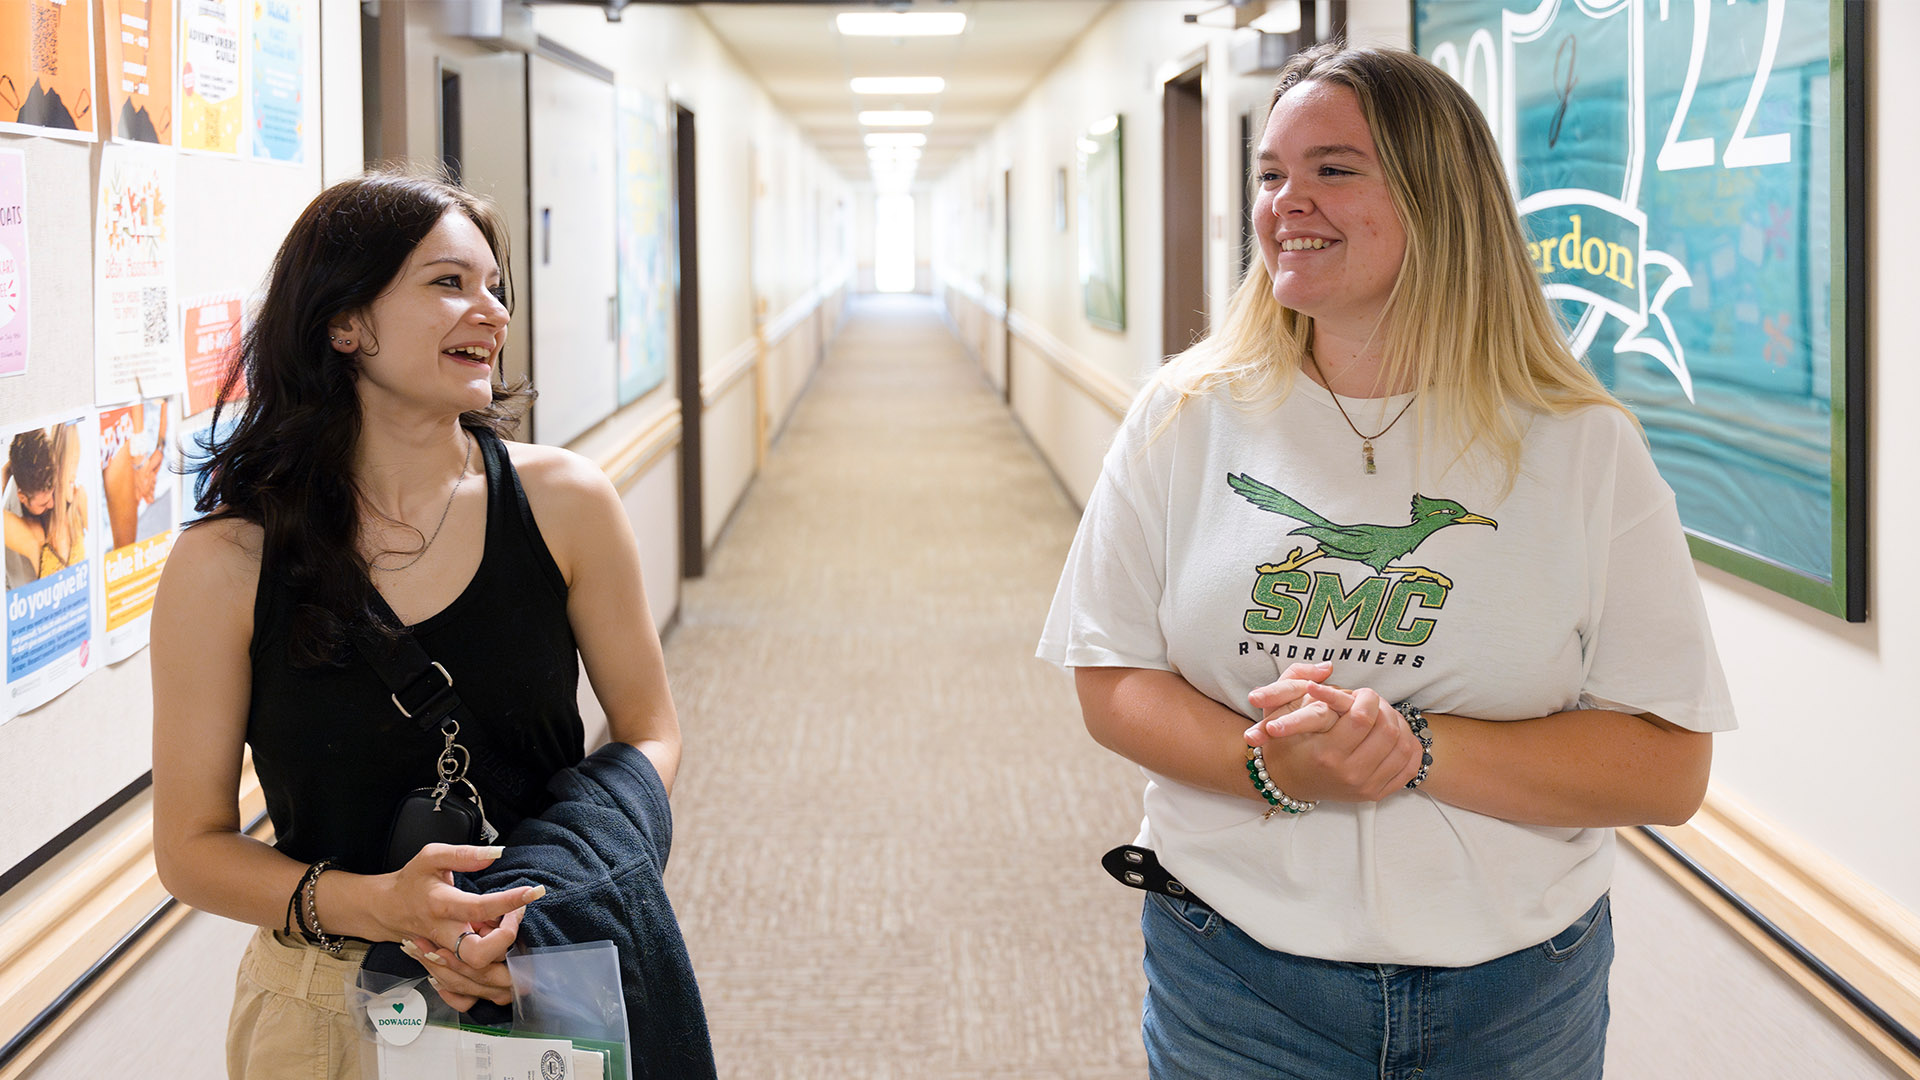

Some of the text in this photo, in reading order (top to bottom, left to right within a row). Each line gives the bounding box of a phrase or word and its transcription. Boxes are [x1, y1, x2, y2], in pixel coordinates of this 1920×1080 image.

[105, 552, 133, 582] take
[134, 545, 144, 572] it
[9, 593, 27, 621] do
[27, 586, 52, 619] you
[52, 574, 75, 609] give
[75, 563, 88, 592] it?
[1243, 570, 1449, 647] SMC
[1239, 641, 1425, 668] ROADRUNNERS
[378, 1018, 422, 1026] DOWAGIAC
